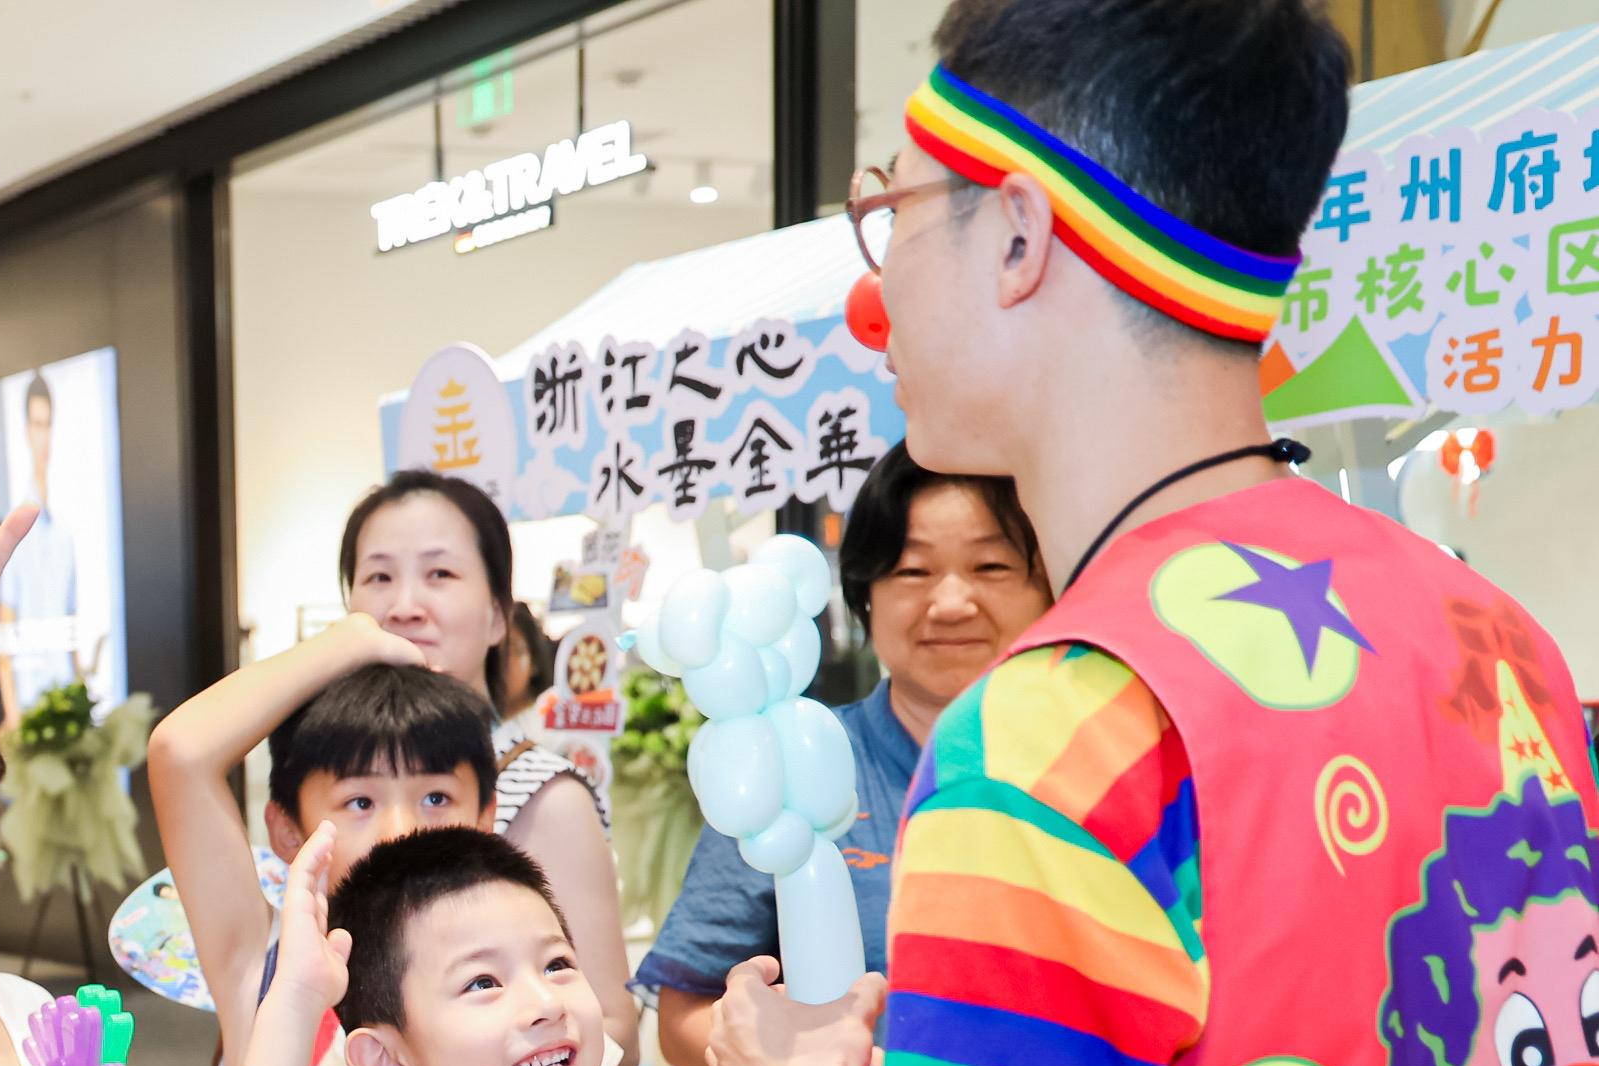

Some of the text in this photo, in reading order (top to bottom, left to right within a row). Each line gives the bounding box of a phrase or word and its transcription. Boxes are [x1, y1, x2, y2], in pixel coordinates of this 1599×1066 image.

[533, 332, 805, 435] 浙江之心
[1443, 315, 1583, 395] 活力
